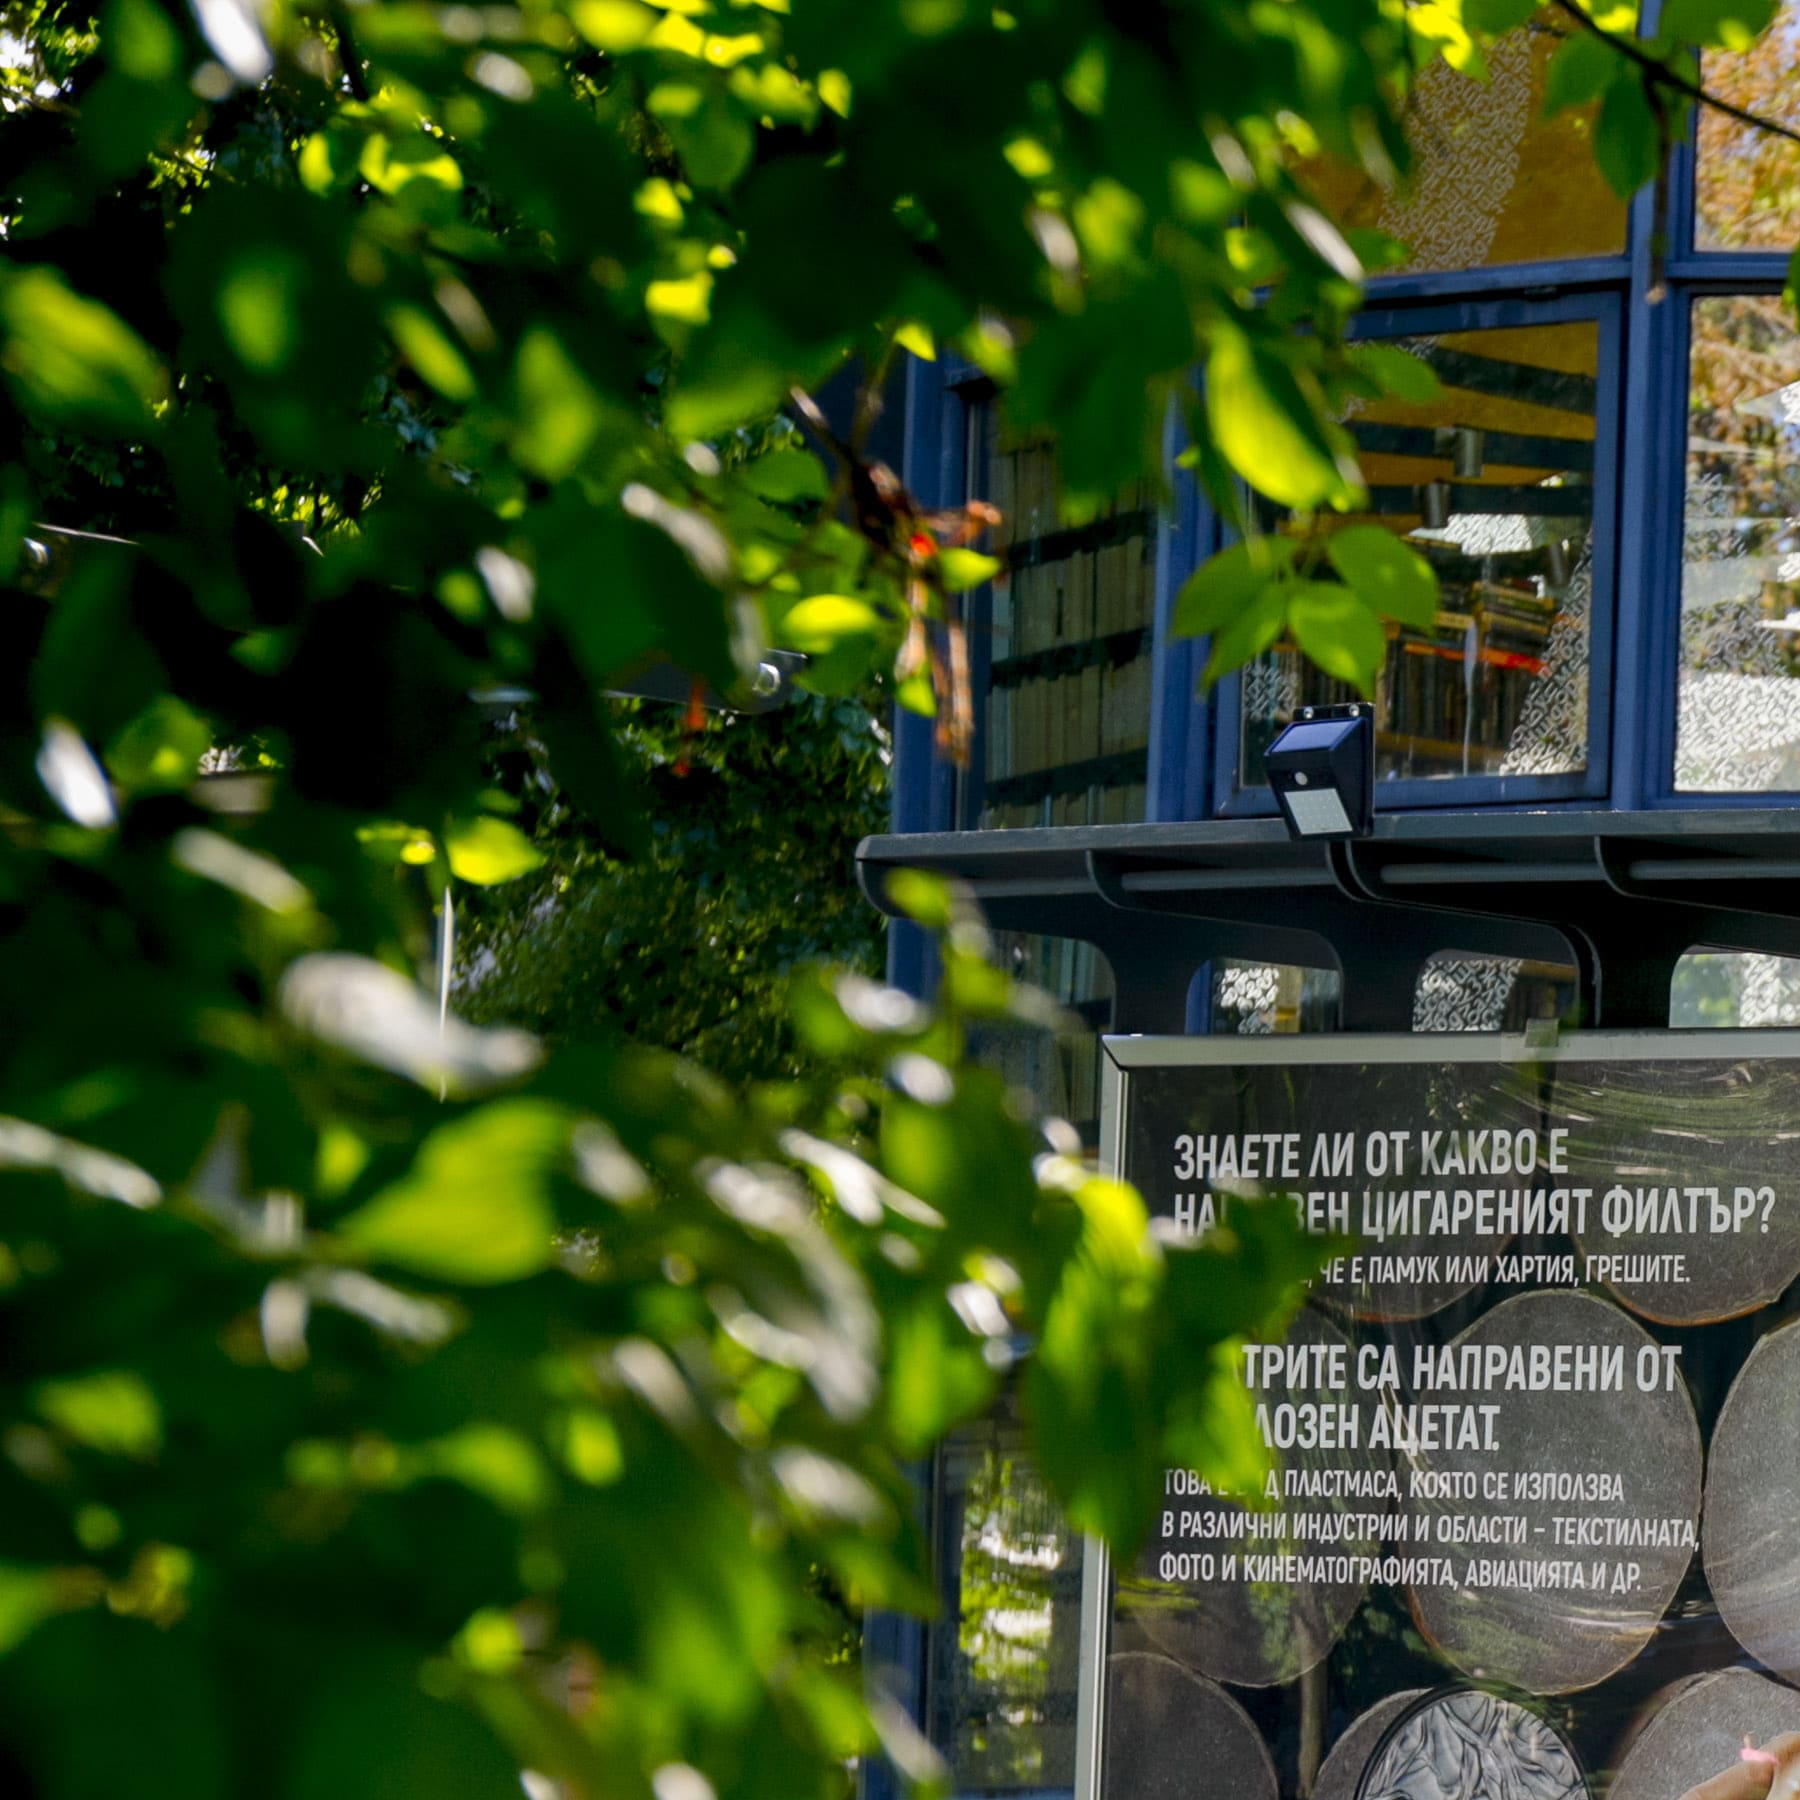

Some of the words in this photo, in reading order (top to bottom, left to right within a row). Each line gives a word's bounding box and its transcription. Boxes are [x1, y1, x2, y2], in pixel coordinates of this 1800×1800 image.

[1173, 1133, 1300, 1180] ЗНАЕТЕ
[1308, 1132, 1355, 1177] ЛИ
[1366, 1130, 1410, 1177] ОТ
[1421, 1128, 1537, 1175] КАКВО
[1549, 1127, 1569, 1174] Е
[1362, 1188, 1593, 1243] ЦИГАРЕНИЯТ
[1602, 1184, 1776, 1238] ФИЛТЪР?
[1351, 1256, 1363, 1283] Е
[1369, 1256, 1438, 1283] ПАМУК
[1445, 1255, 1488, 1283] ИЛИ
[1495, 1255, 1579, 1287] ХАРТИЯ,
[1585, 1255, 1691, 1283] ГРЕШИТЕ.
[1240, 1344, 1347, 1390] ТРИТЕ
[1357, 1343, 1401, 1390] СА
[1412, 1344, 1624, 1391] НАПРАВЕНИ
[1636, 1344, 1683, 1392] ОТ
[1255, 1403, 1359, 1449] ЛОЗЕН
[1368, 1403, 1500, 1457] АЦЕТАТ.
[1164, 1468, 1211, 1495] ТОВА
[1285, 1469, 1402, 1502] ПЛАСТМАСА,
[1409, 1471, 1477, 1499] КОЯТО
[1483, 1471, 1508, 1499] СЕ
[1514, 1473, 1624, 1501] ИЗПОЛЗВА
[1161, 1510, 1174, 1538] В
[1179, 1511, 1286, 1540] РАЗЛИЧНИ
[1293, 1512, 1408, 1544] ИНДУСТРИИ
[1414, 1515, 1430, 1542] И
[1437, 1515, 1528, 1544] ОБЛАСТИ
[1552, 1516, 1700, 1552] ТЕКСТИЛНАТА,
[1159, 1551, 1215, 1582] ФОТО
[1221, 1555, 1236, 1582] И
[1243, 1555, 1458, 1590] КИНЕМАТОГРАФИЯТА,
[1465, 1559, 1585, 1592] АВИАЦИЯТА
[1591, 1561, 1606, 1589] И
[1610, 1562, 1642, 1595] ДР.
